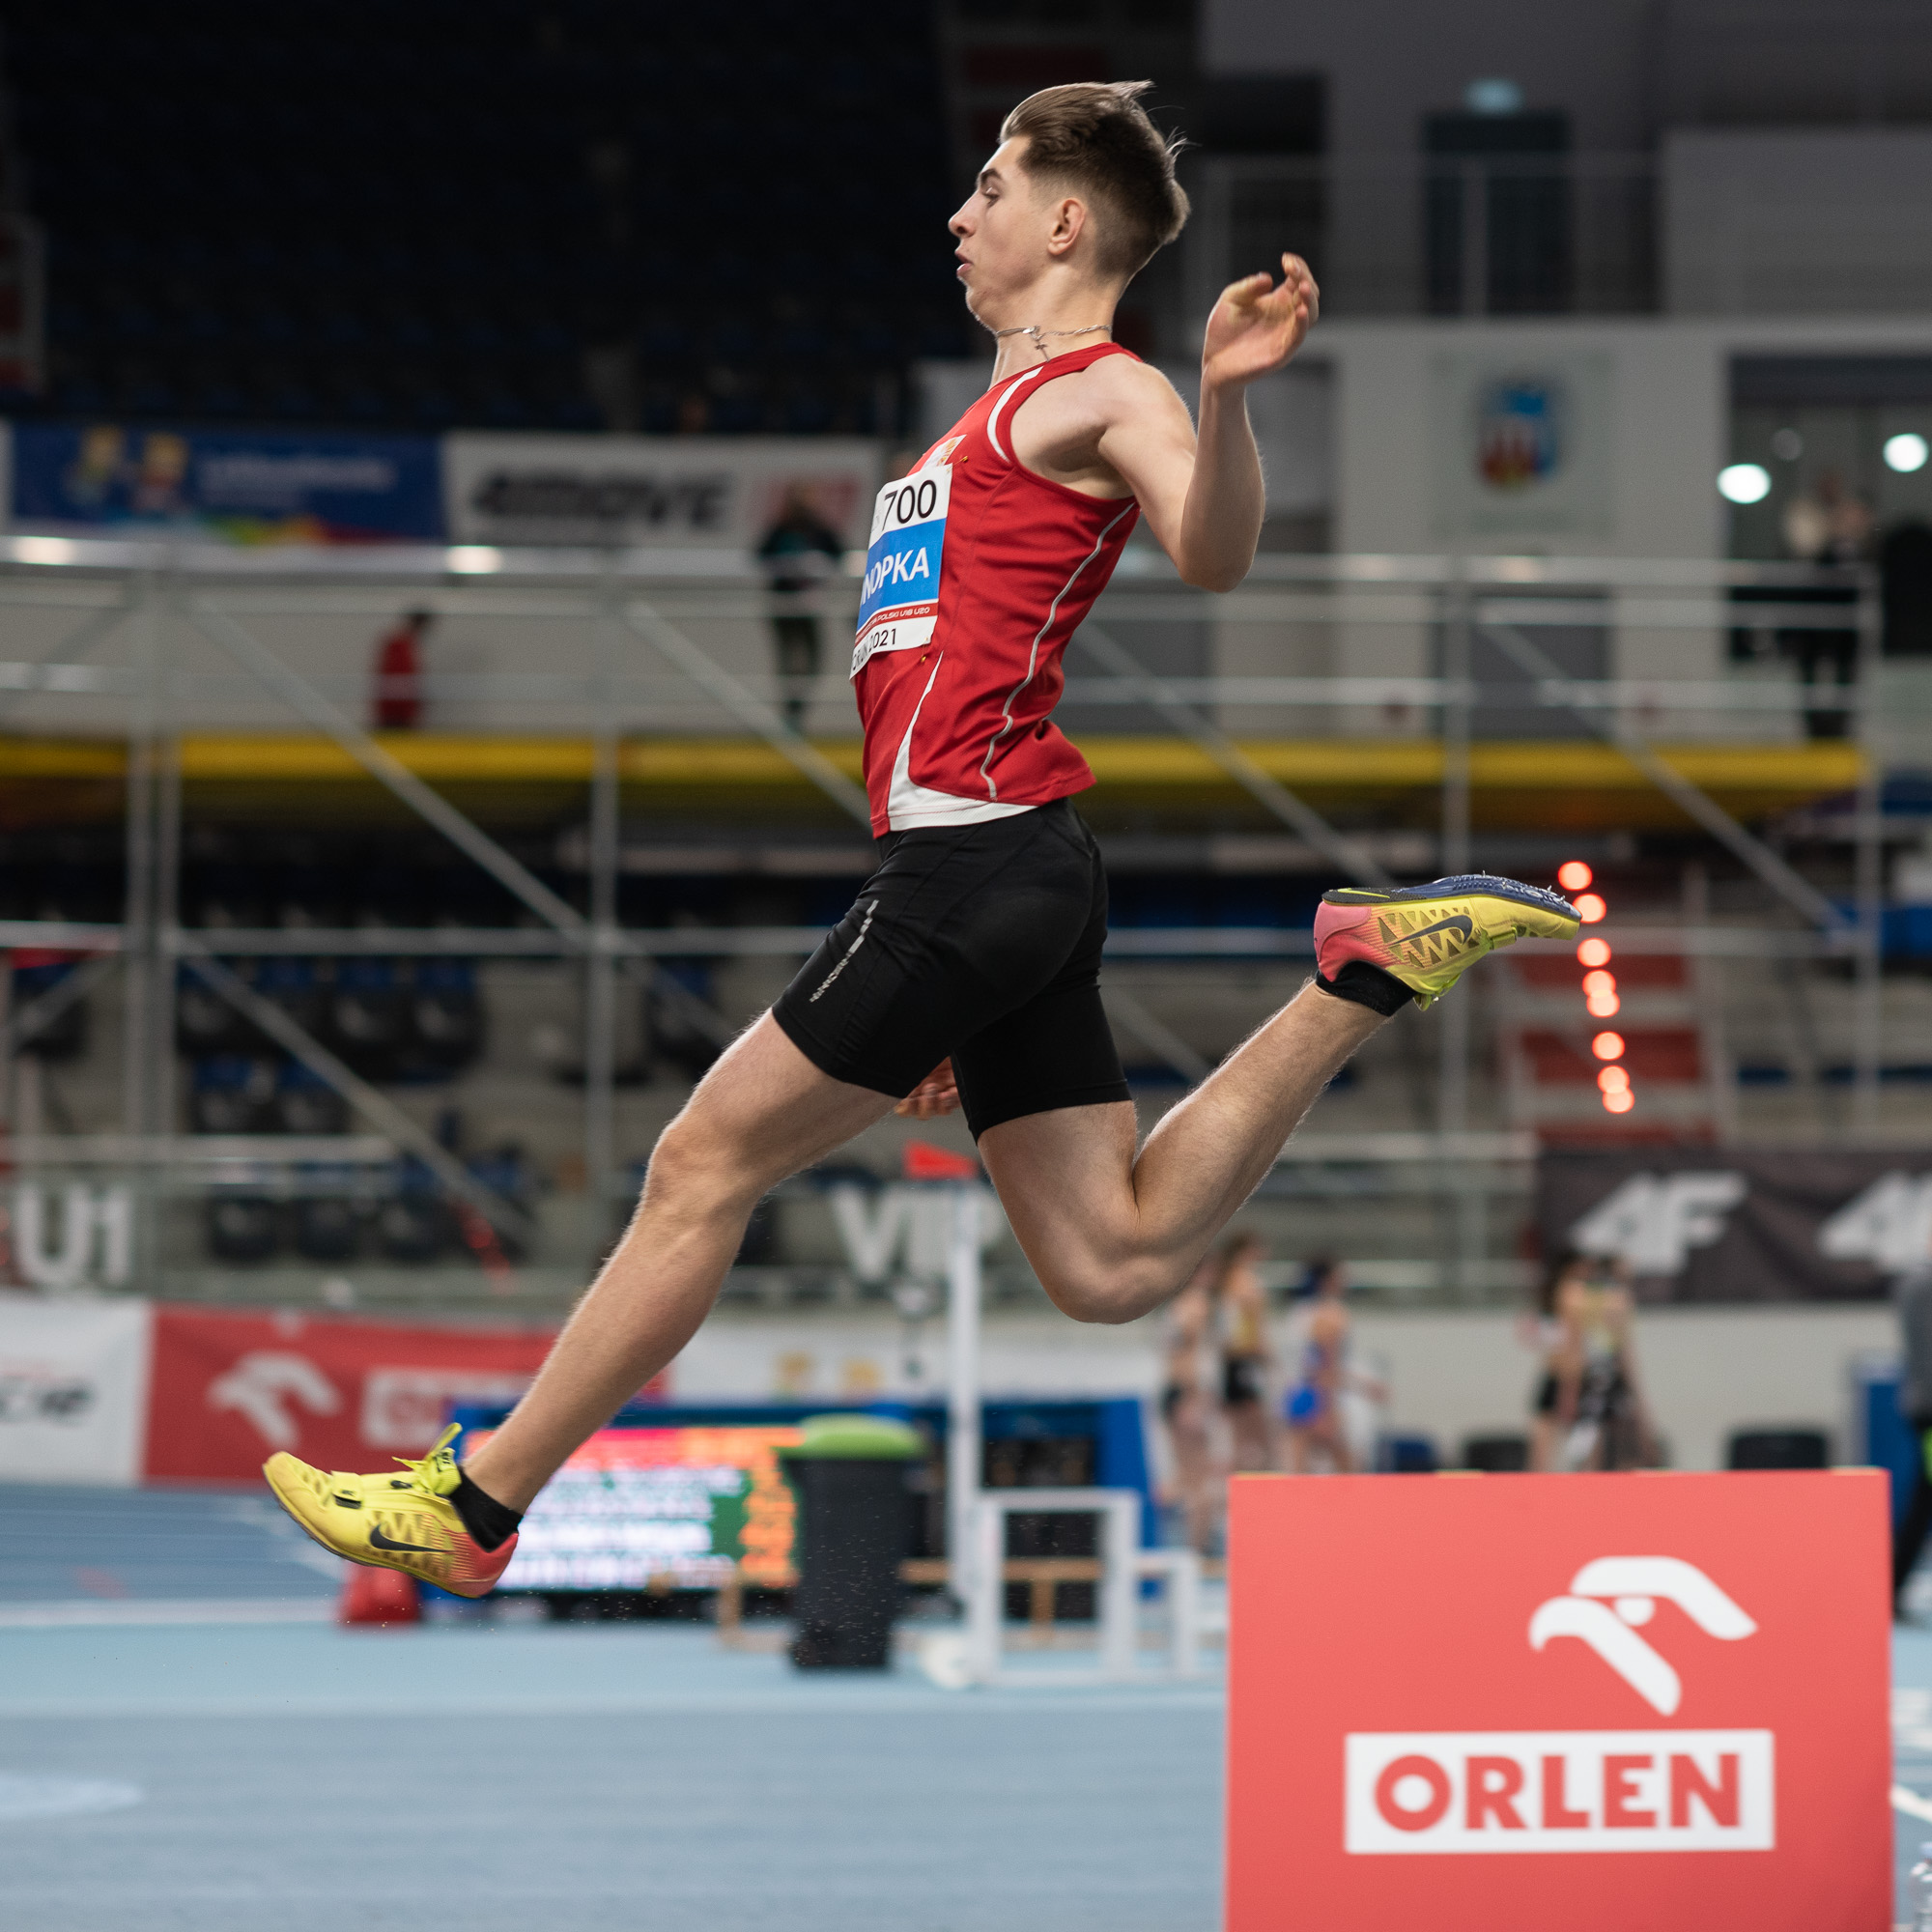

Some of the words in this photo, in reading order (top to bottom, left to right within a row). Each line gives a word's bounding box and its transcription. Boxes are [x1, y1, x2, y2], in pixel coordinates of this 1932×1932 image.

[881, 480, 937, 531] 700
[1573, 1170, 1747, 1273] 4F
[1375, 1754, 1742, 1833] ORLEN
